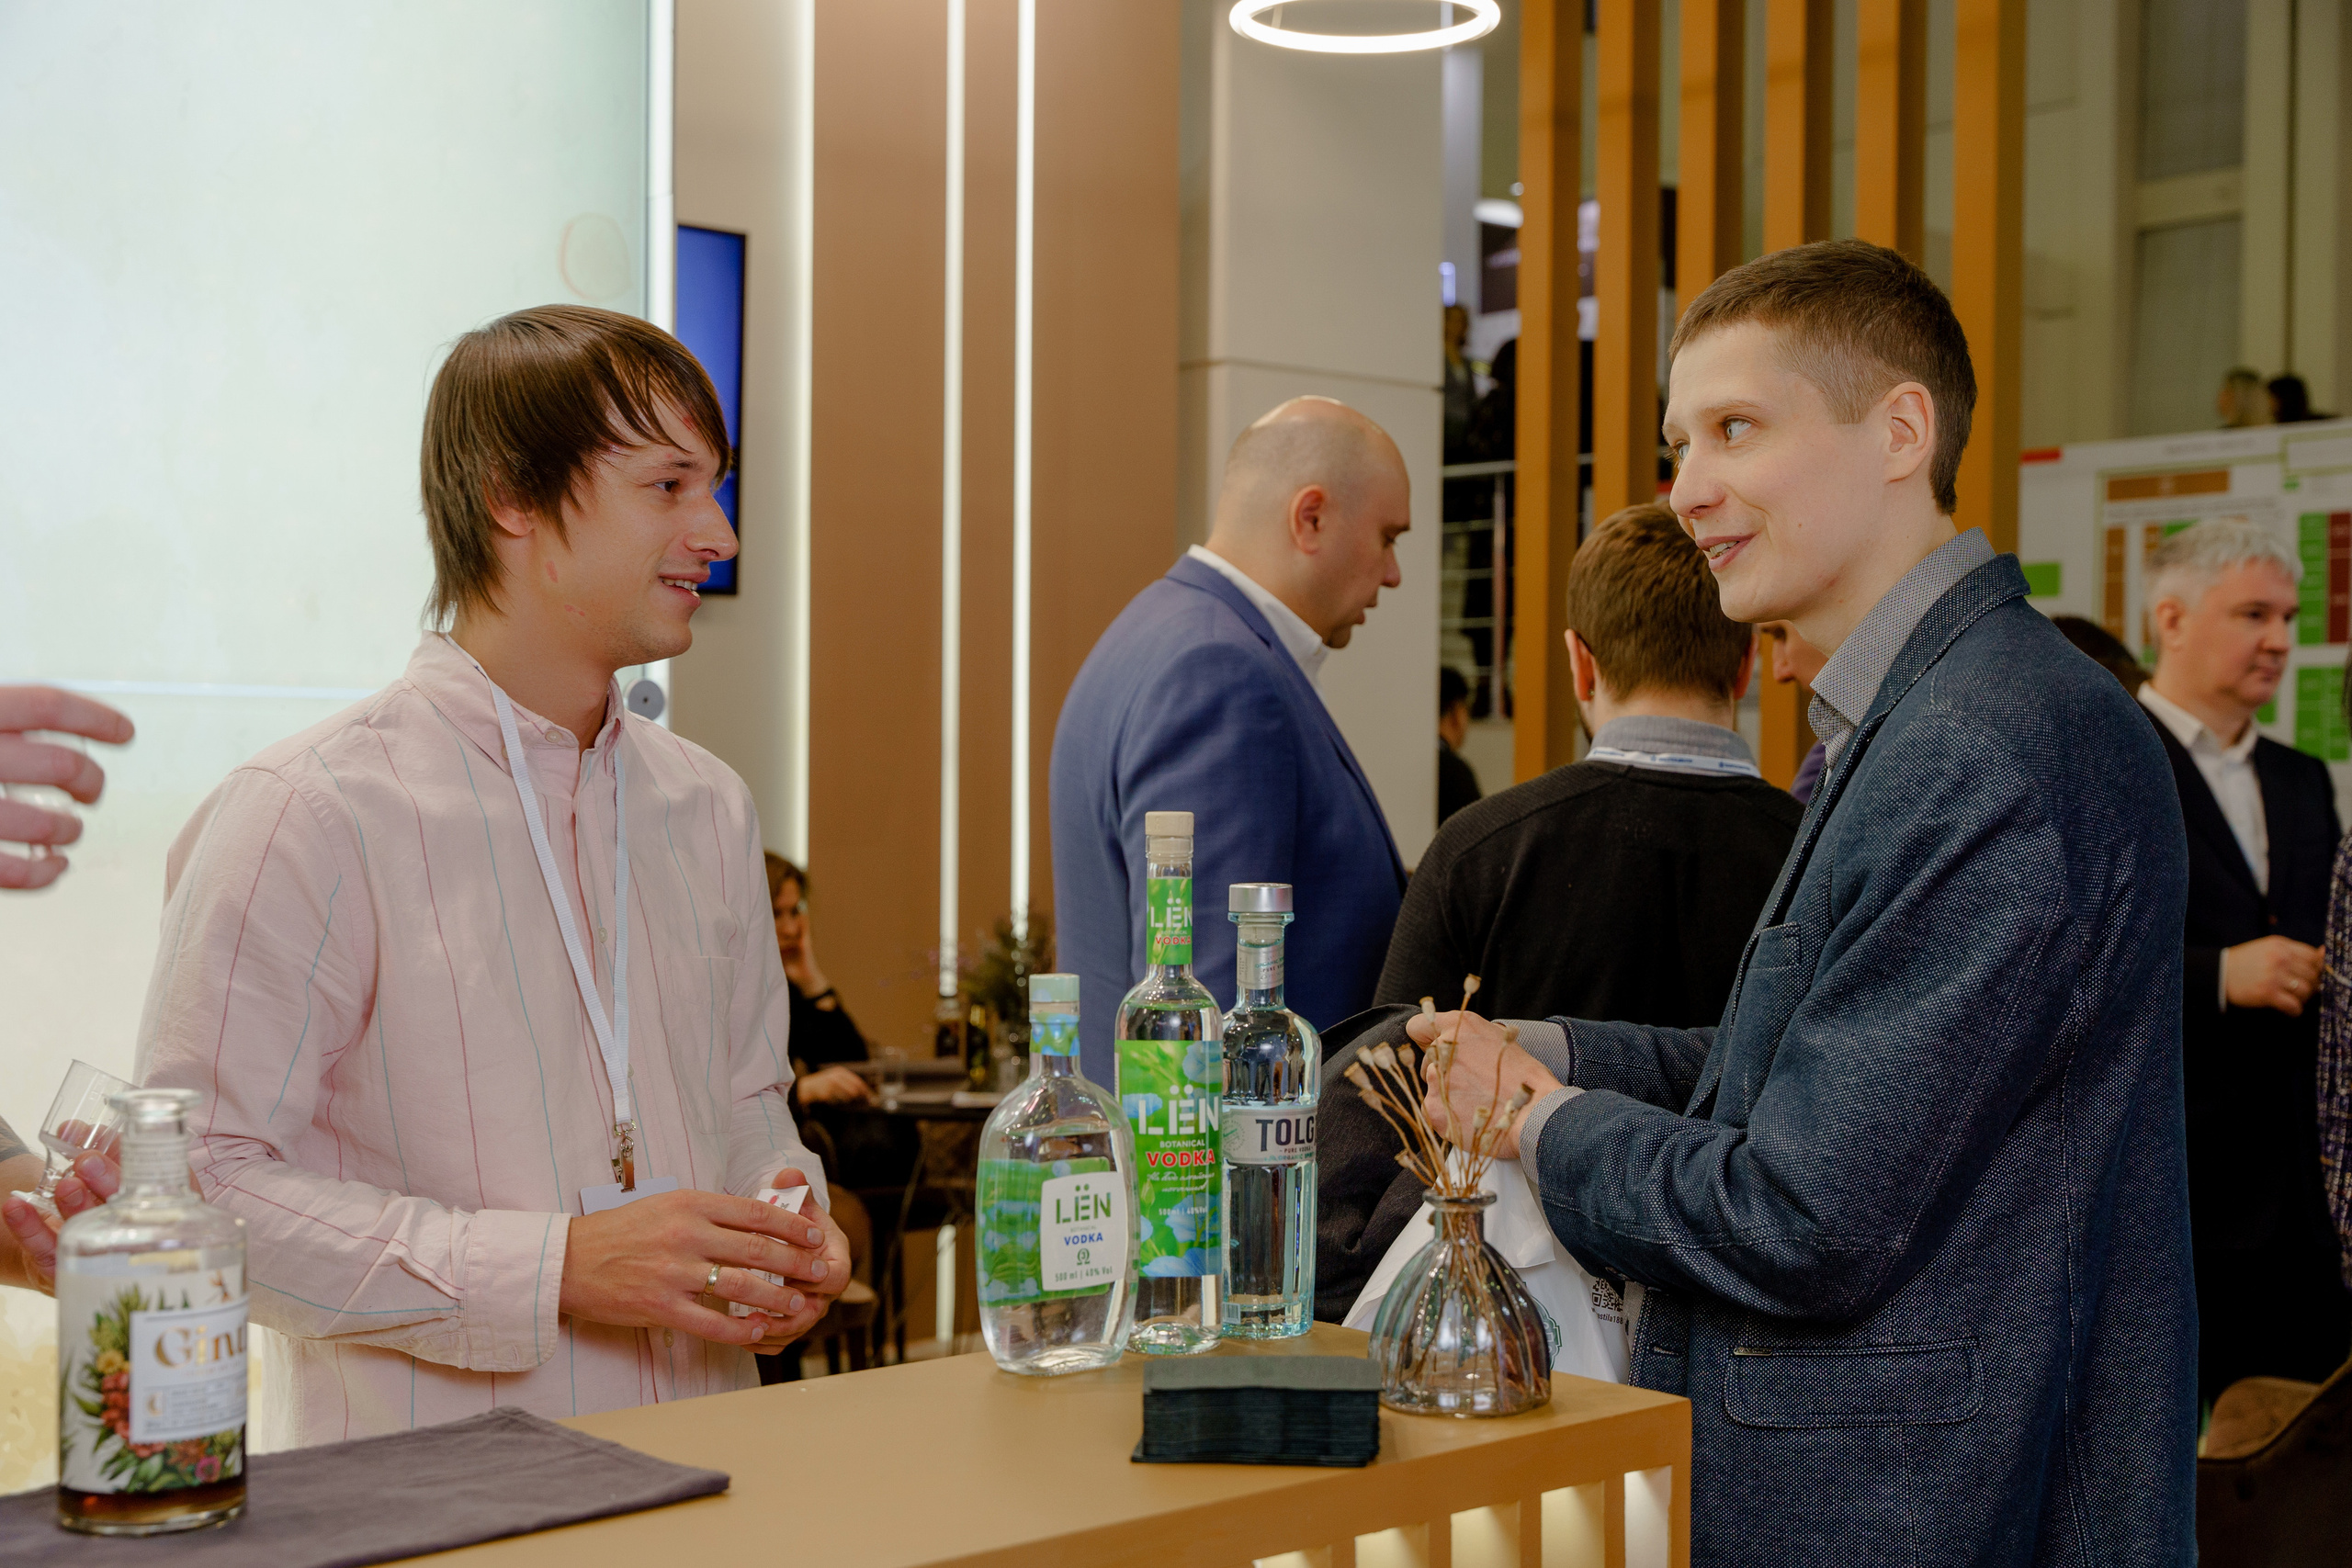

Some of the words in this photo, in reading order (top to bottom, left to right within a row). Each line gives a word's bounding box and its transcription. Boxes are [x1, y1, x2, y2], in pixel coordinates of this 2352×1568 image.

[1155, 936, 1192, 945] VODKA
[1138, 1084, 1219, 1135] LËN
[1255, 1115, 1315, 1152] TOLG
[1159, 1139, 1205, 1148] BOTANICAL
[1146, 1148, 1216, 1168] VODKA
[1056, 1183, 1111, 1224] LËN
[1064, 1232, 1103, 1246] VODKA
[1055, 1272, 1068, 1282] 500
[1069, 1270, 1078, 1280] ml
[1085, 1268, 1100, 1277] 40%
[1102, 1266, 1114, 1275] Vol
